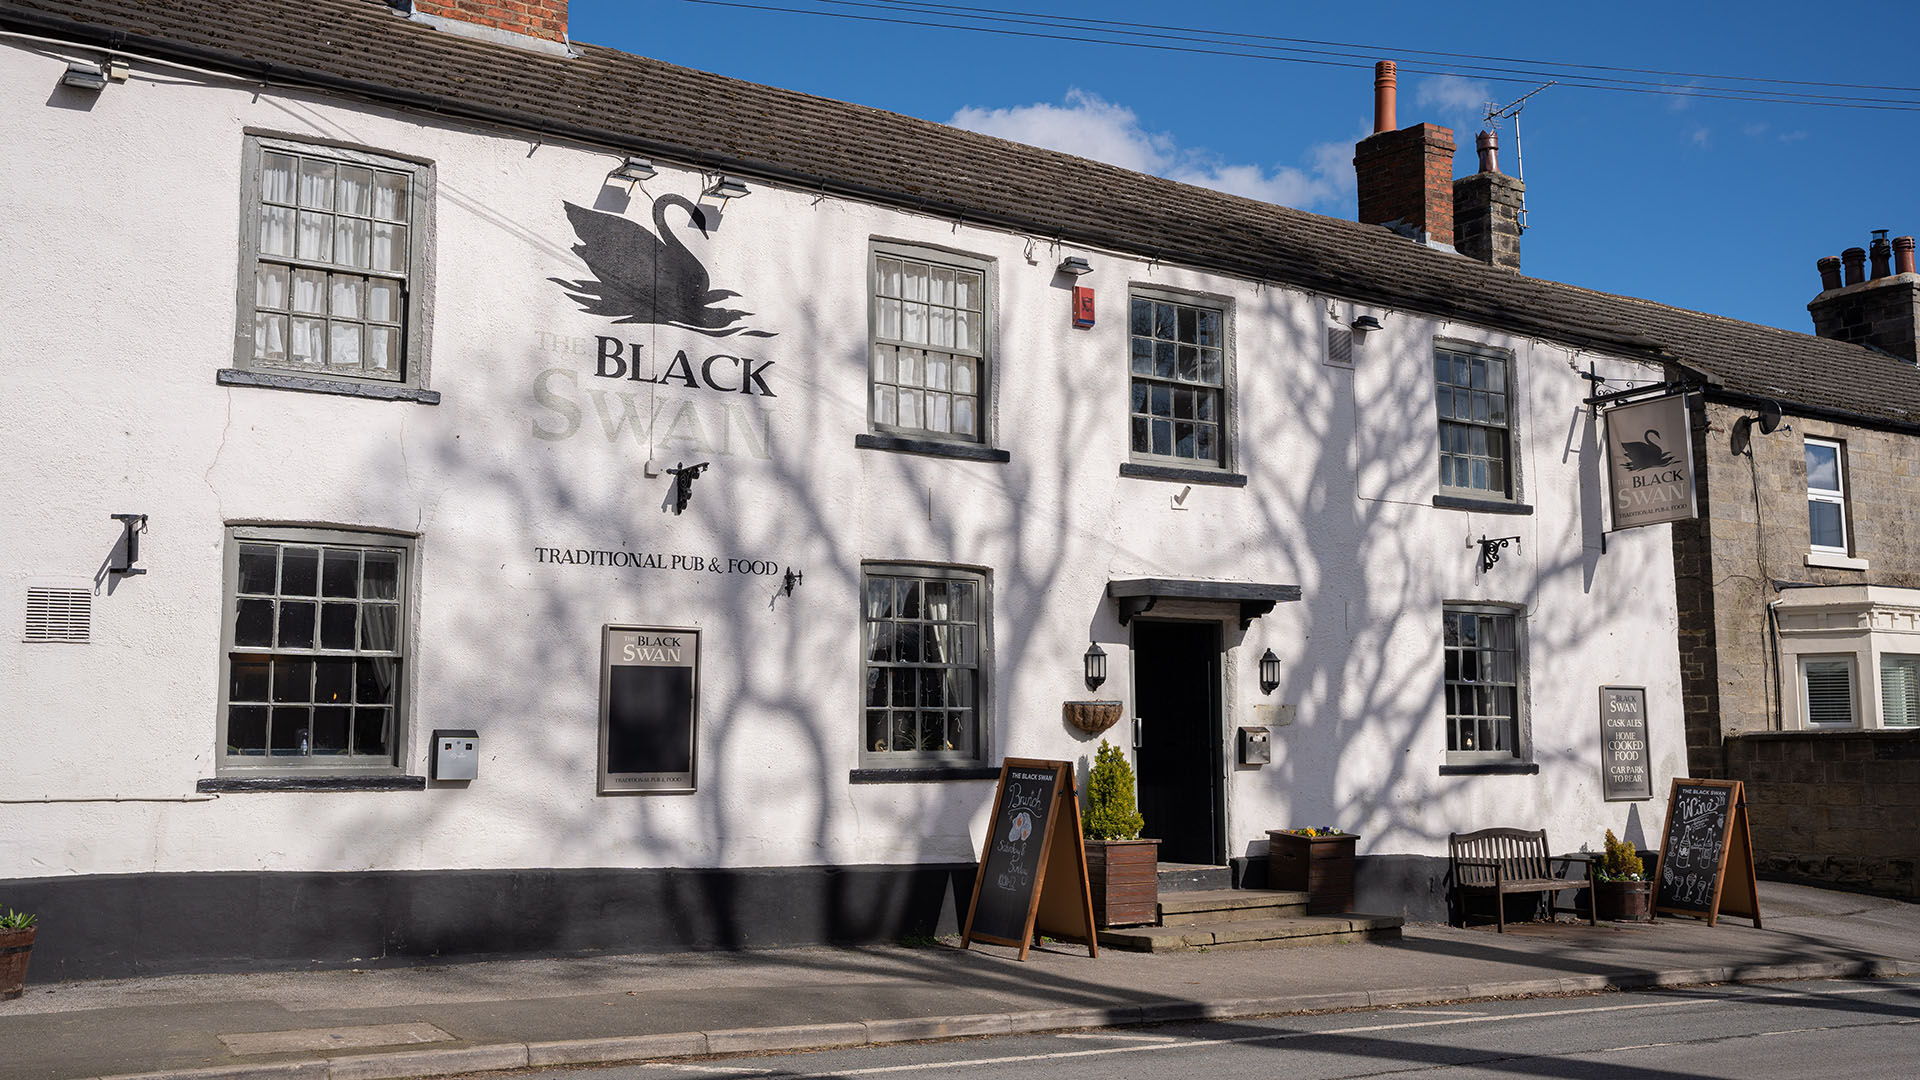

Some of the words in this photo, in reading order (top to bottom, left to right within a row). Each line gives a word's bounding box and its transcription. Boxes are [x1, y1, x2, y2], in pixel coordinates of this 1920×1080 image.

[535, 331, 586, 355] THE
[594, 335, 777, 397] BLACK
[531, 368, 775, 460] SWAN
[1632, 469, 1684, 488] BLACK
[1618, 483, 1685, 510] SWAN
[535, 547, 668, 569] TRADITIONAL
[671, 555, 705, 571] PUB
[708, 557, 724, 574] &
[728, 559, 778, 575] FOOD
[637, 635, 681, 647] BLACK
[623, 644, 681, 662] SWAN
[1616, 694, 1637, 702] BLACK
[1610, 700, 1637, 713] SWAN
[1607, 719, 1625, 728] CASK
[1626, 719, 1643, 728] ALES
[1615, 731, 1636, 740] HOME
[1608, 740, 1644, 751] COOKED
[1615, 750, 1639, 761] FOOD
[1610, 766, 1626, 774] CAR
[1626, 766, 1644, 774] PARK
[1613, 775, 1624, 783] TO
[1625, 775, 1643, 783] REAR
[1679, 797, 1720, 820] Wine
